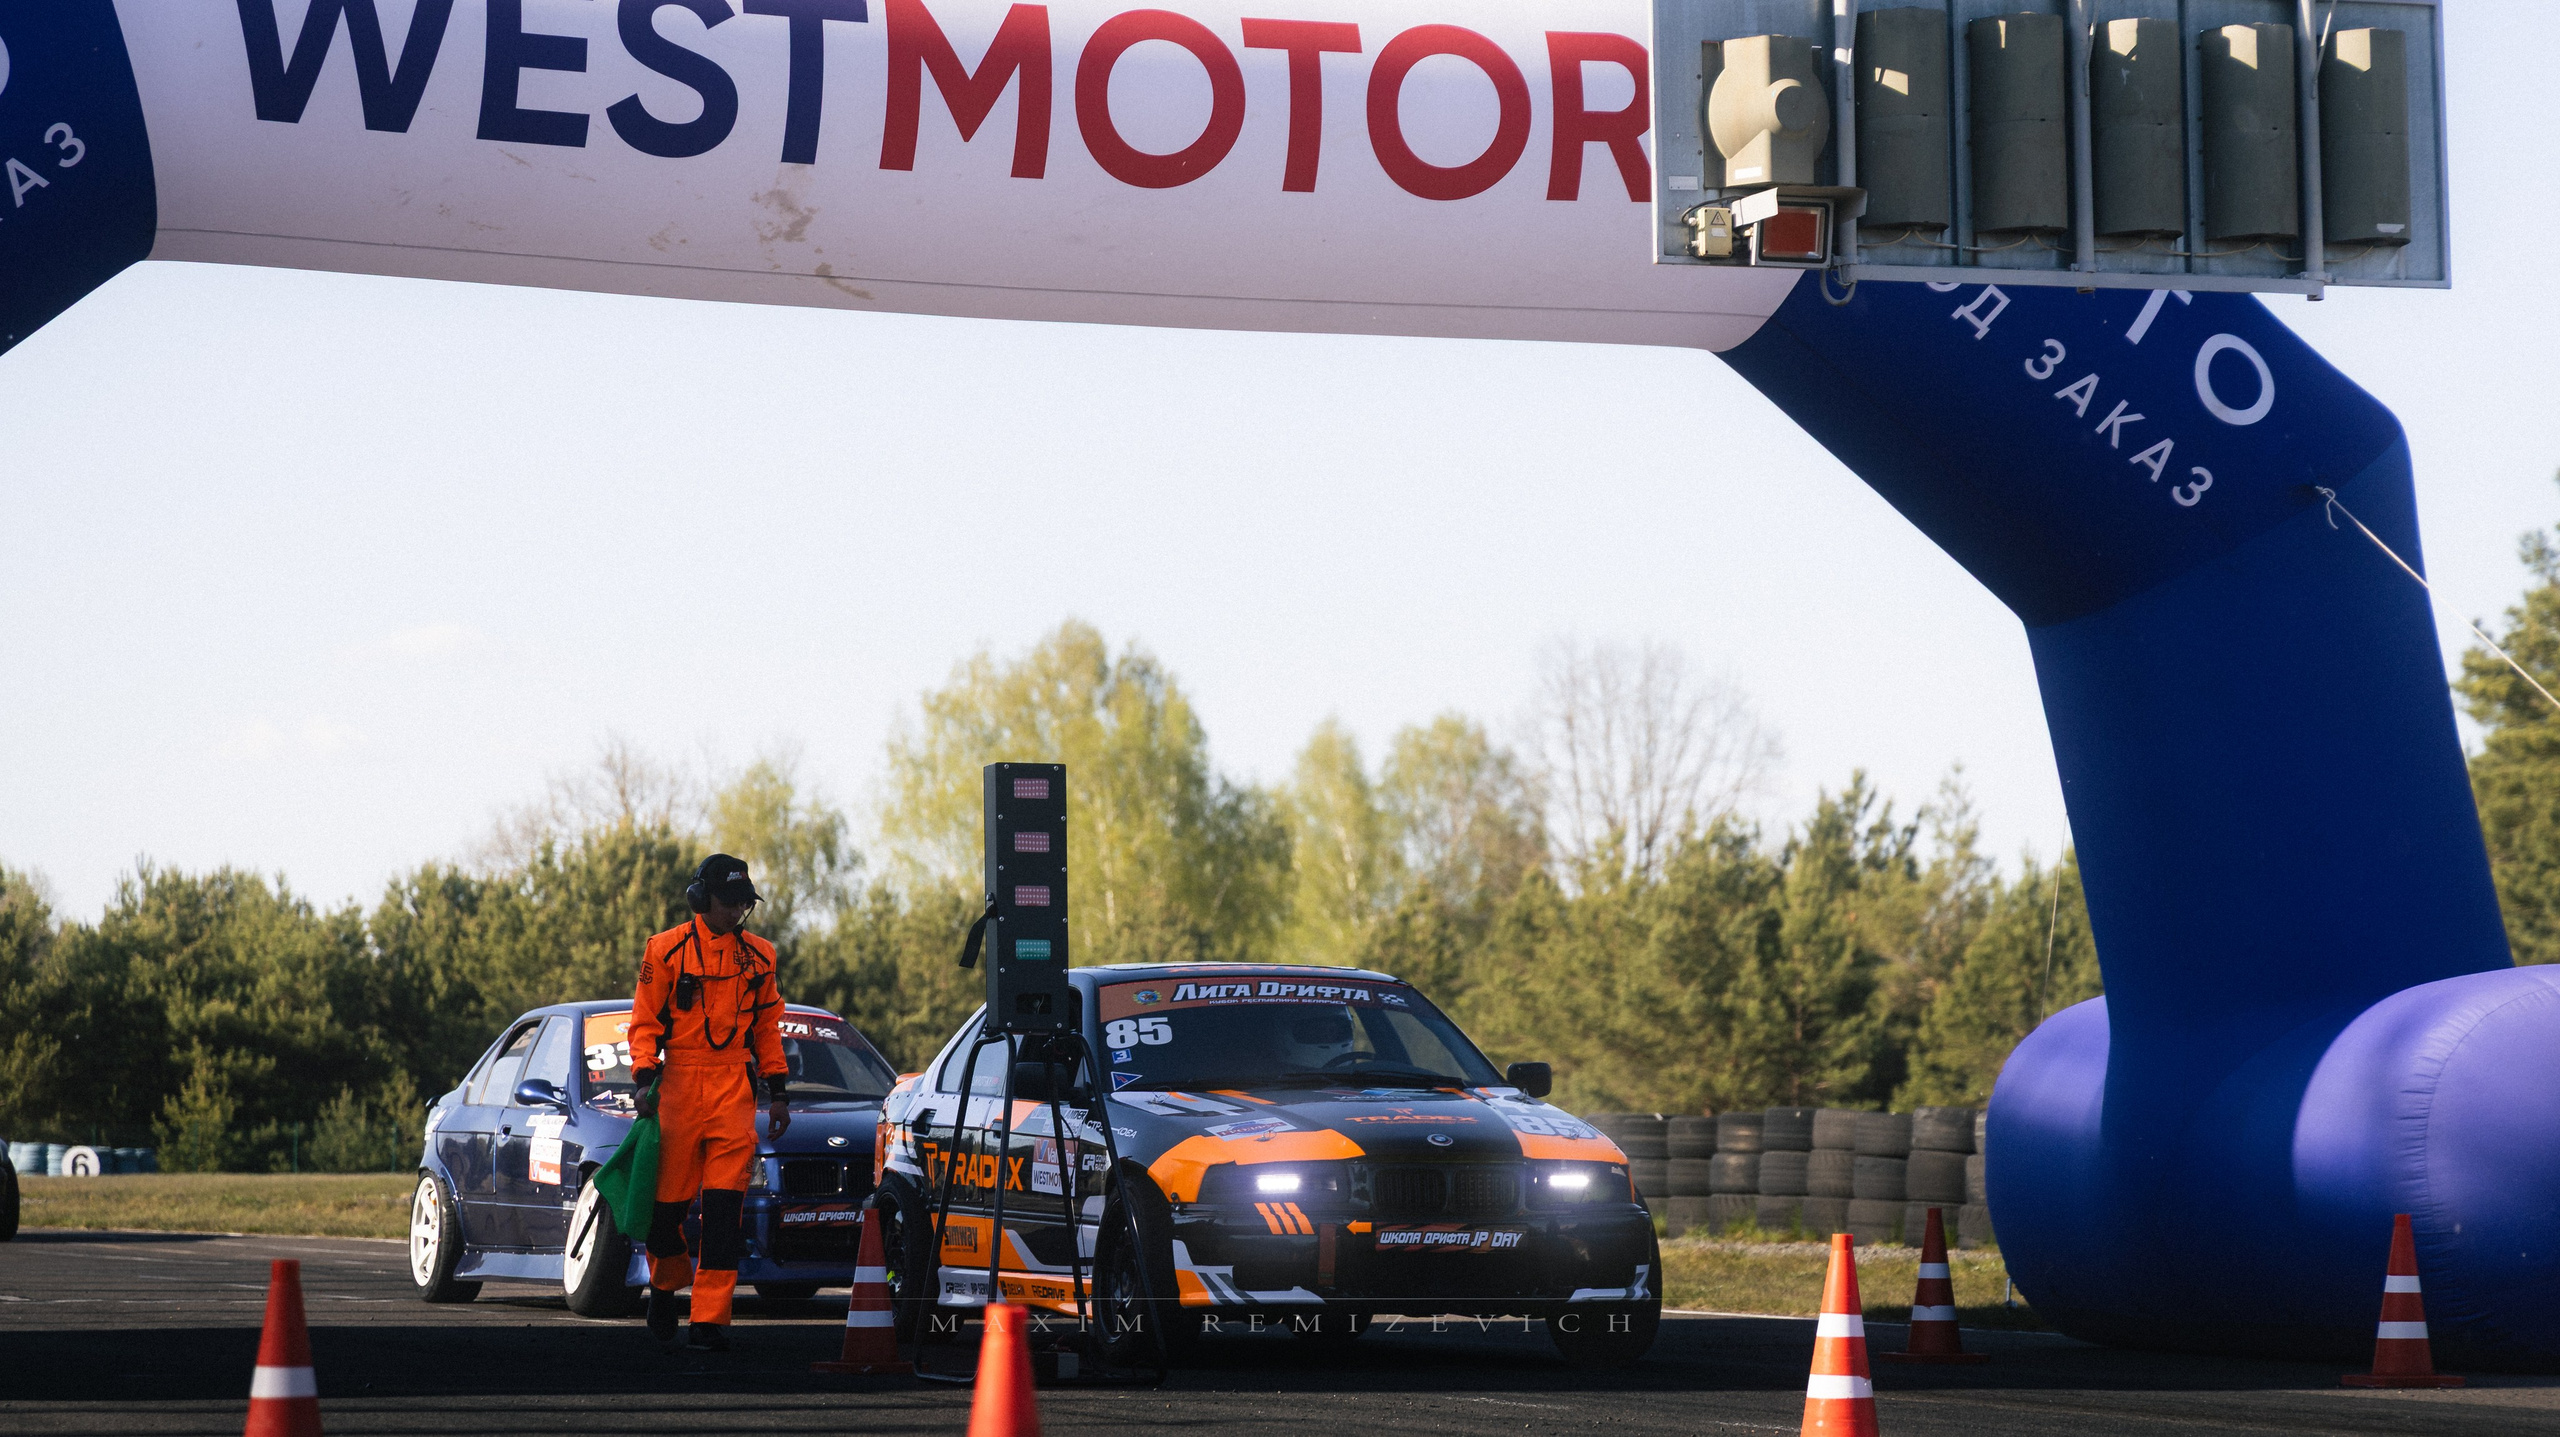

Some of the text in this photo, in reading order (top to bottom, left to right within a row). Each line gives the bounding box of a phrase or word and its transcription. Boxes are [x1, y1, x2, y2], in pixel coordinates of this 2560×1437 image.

[2024, 338, 2213, 507] ЗАКАЗ
[1105, 1017, 1172, 1049] 85
[1507, 1114, 1597, 1139] 85
[72, 1153, 89, 1177] 6
[784, 1212, 816, 1222] ШКОЛА
[818, 1211, 856, 1221] ДРИФТА
[1380, 1231, 1522, 1248] ШКОЛА ДРИФТА JP DAY
